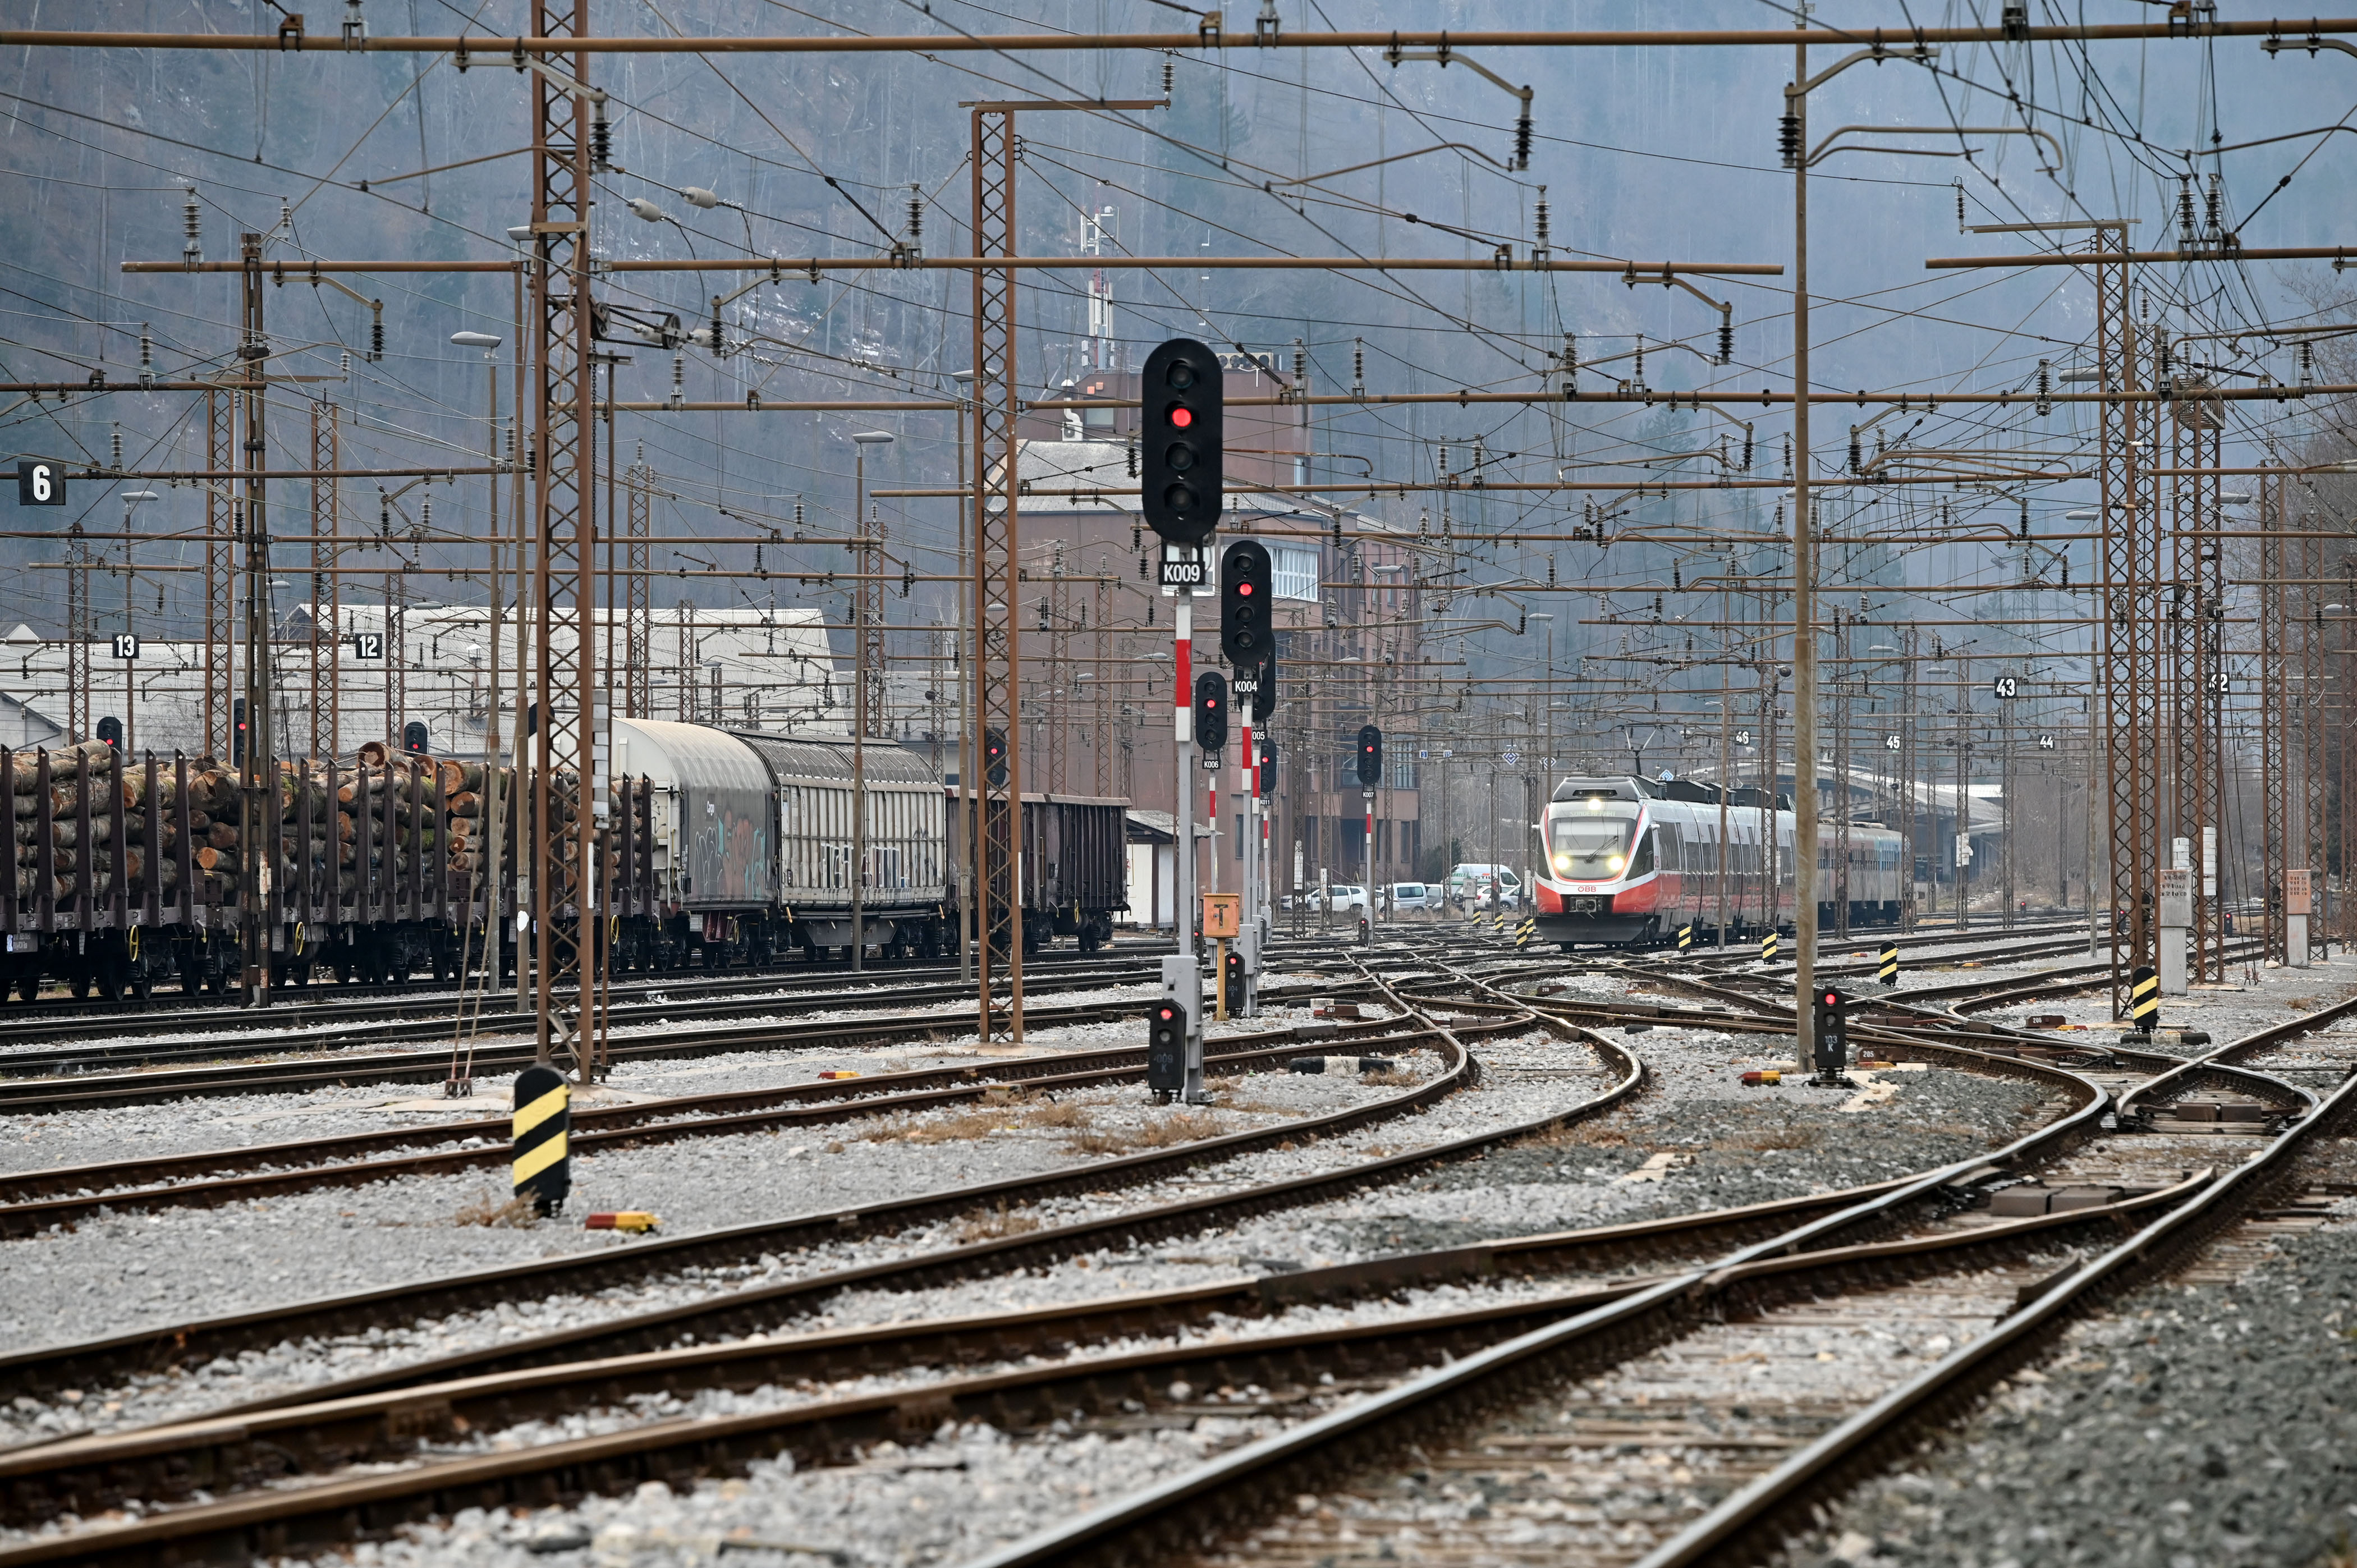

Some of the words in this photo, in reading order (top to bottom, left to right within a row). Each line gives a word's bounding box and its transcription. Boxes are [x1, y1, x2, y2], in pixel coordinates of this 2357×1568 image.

[33, 465, 51, 501] 6
[1164, 564, 1200, 582] K009
[116, 635, 135, 657] 13
[359, 635, 378, 657] 12
[1235, 681, 1258, 692] K004
[1996, 678, 2015, 696] 43
[1252, 731, 1265, 740] 005
[1886, 735, 1900, 749] 45
[2039, 735, 2053, 748] 44
[1214, 904, 1228, 928] T
[1825, 1035, 1837, 1044] 103
[1157, 1054, 1173, 1063] 009
[1162, 1063, 1167, 1073] K
